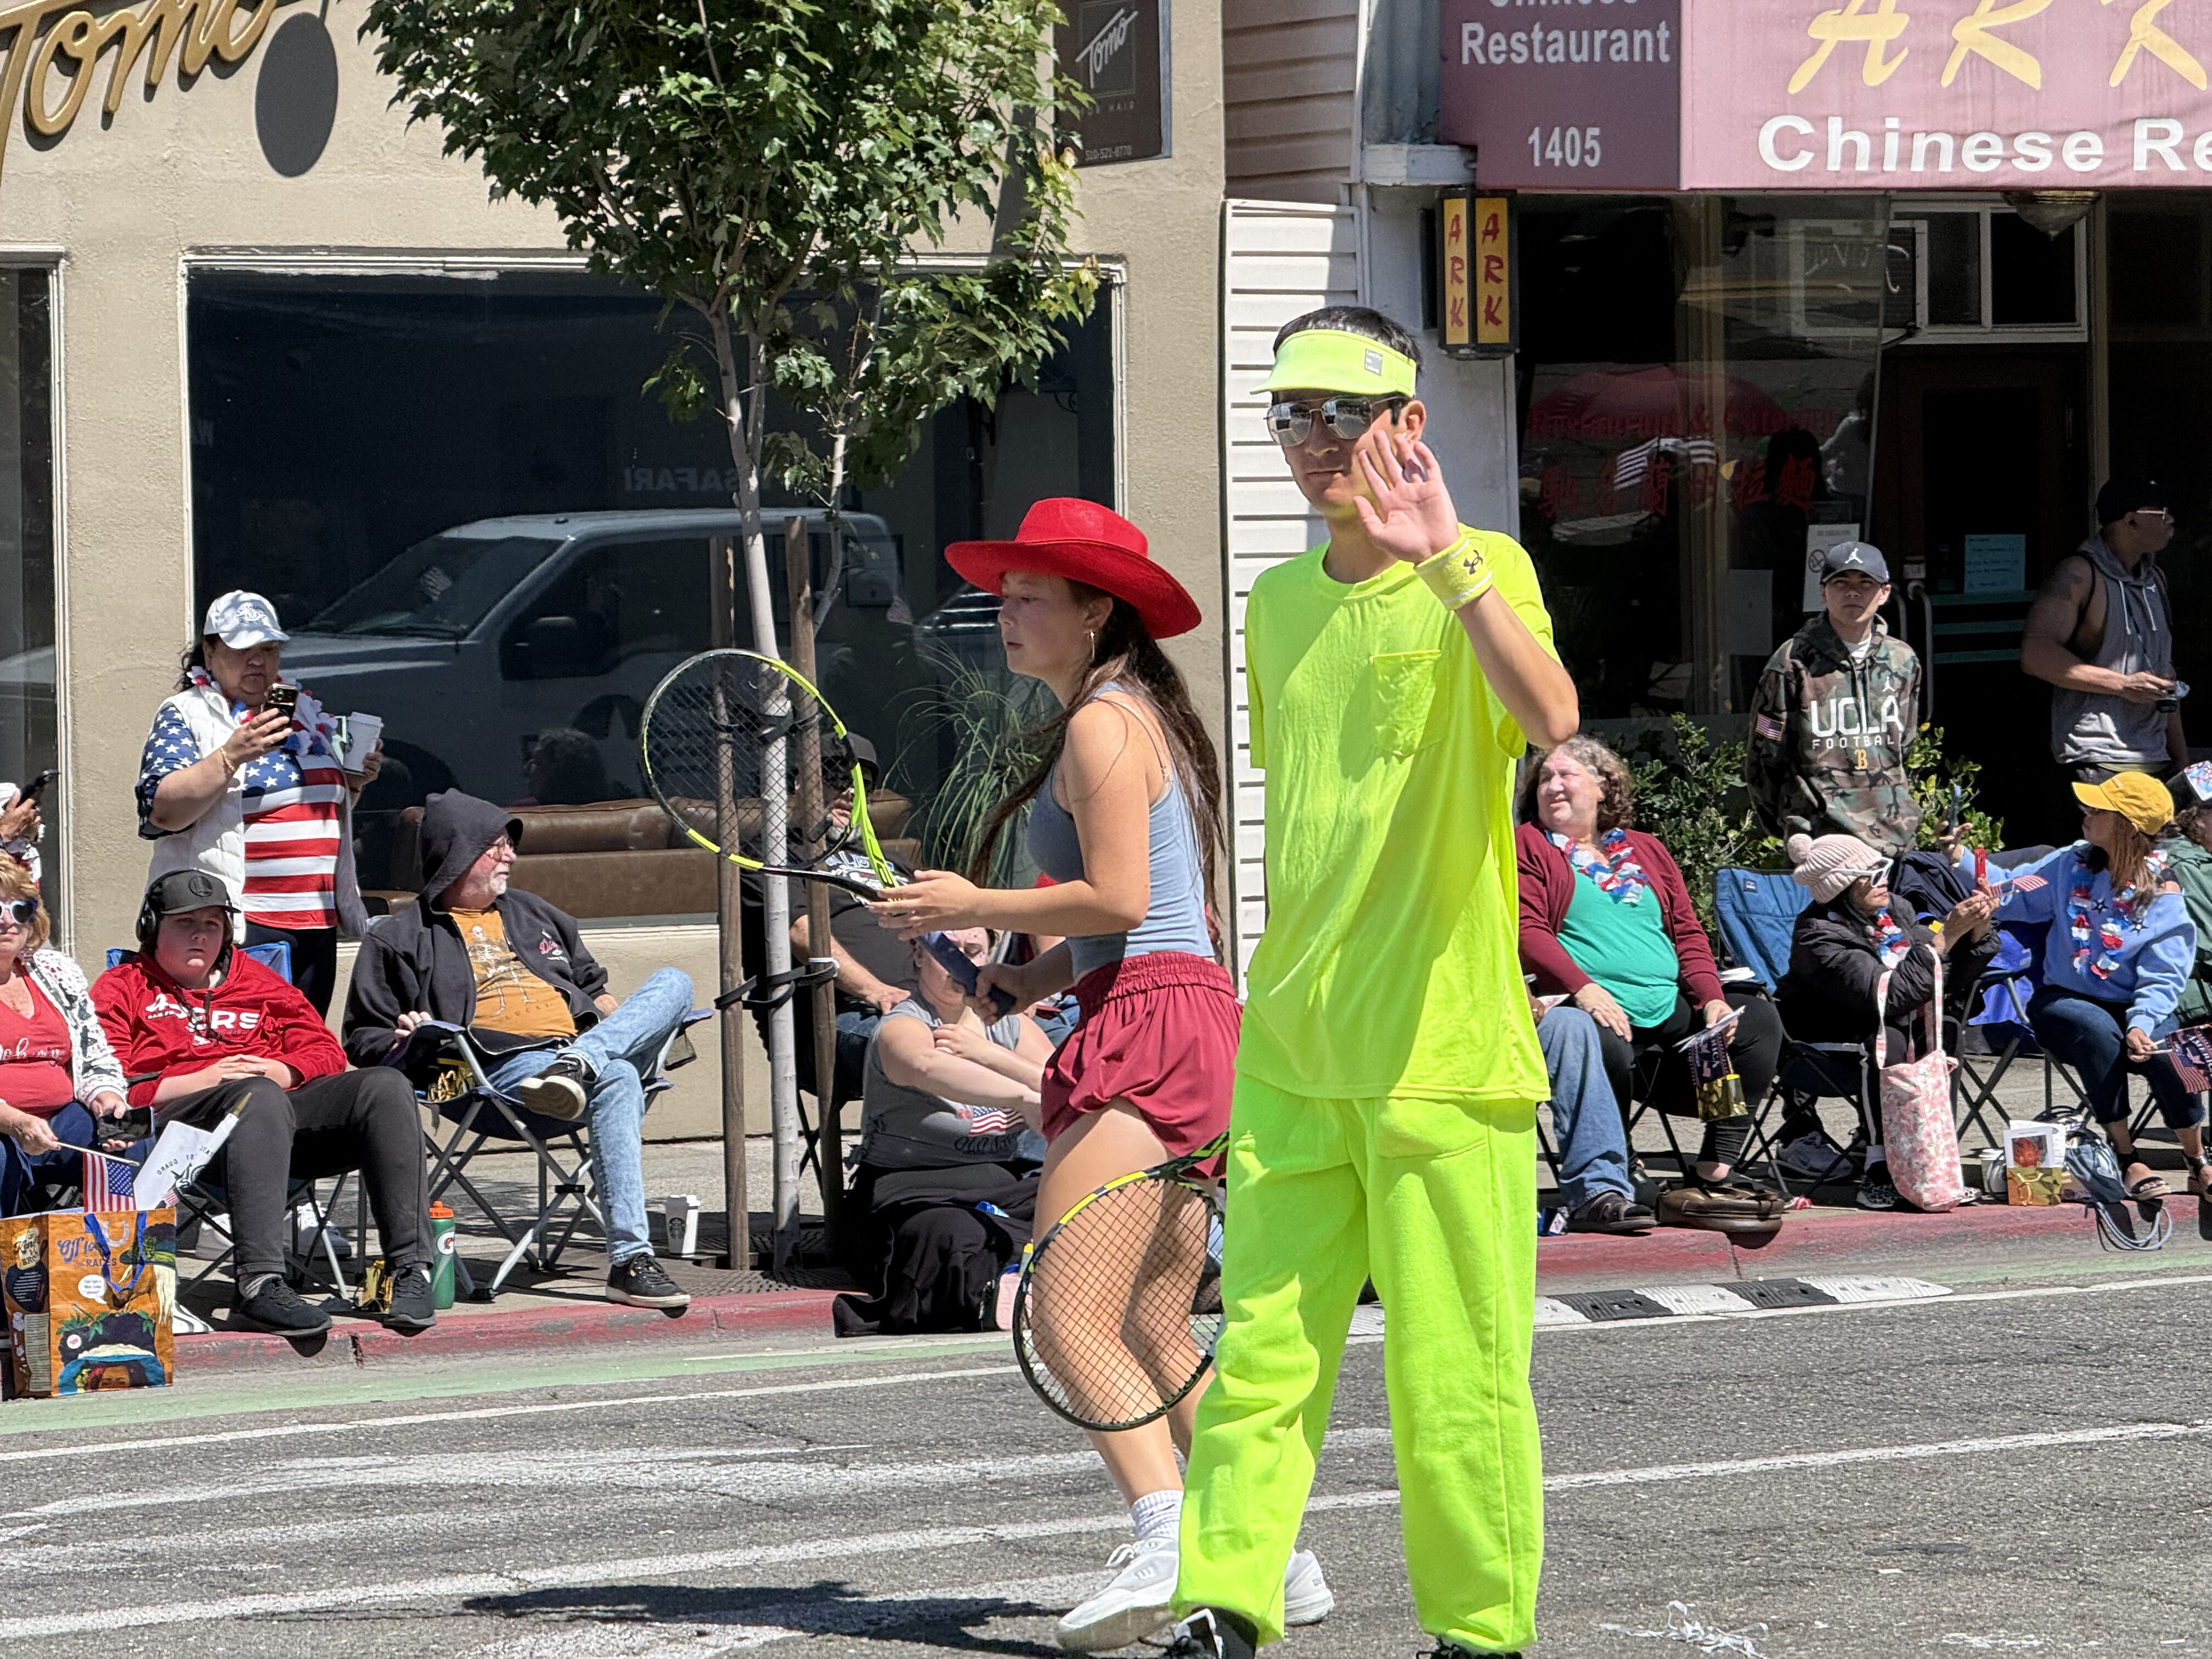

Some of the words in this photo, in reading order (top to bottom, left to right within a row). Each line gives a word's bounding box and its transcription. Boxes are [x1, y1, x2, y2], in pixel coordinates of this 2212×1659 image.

[1075, 8, 1139, 89] Tomo
[1461, 20, 1671, 65] Restaurant
[1527, 126, 1601, 168] 1405
[1758, 114, 2104, 172] Chinese
[1446, 213, 1465, 328] ARK
[1481, 212, 1504, 326] ARK
[1811, 695, 1904, 737] UCLA
